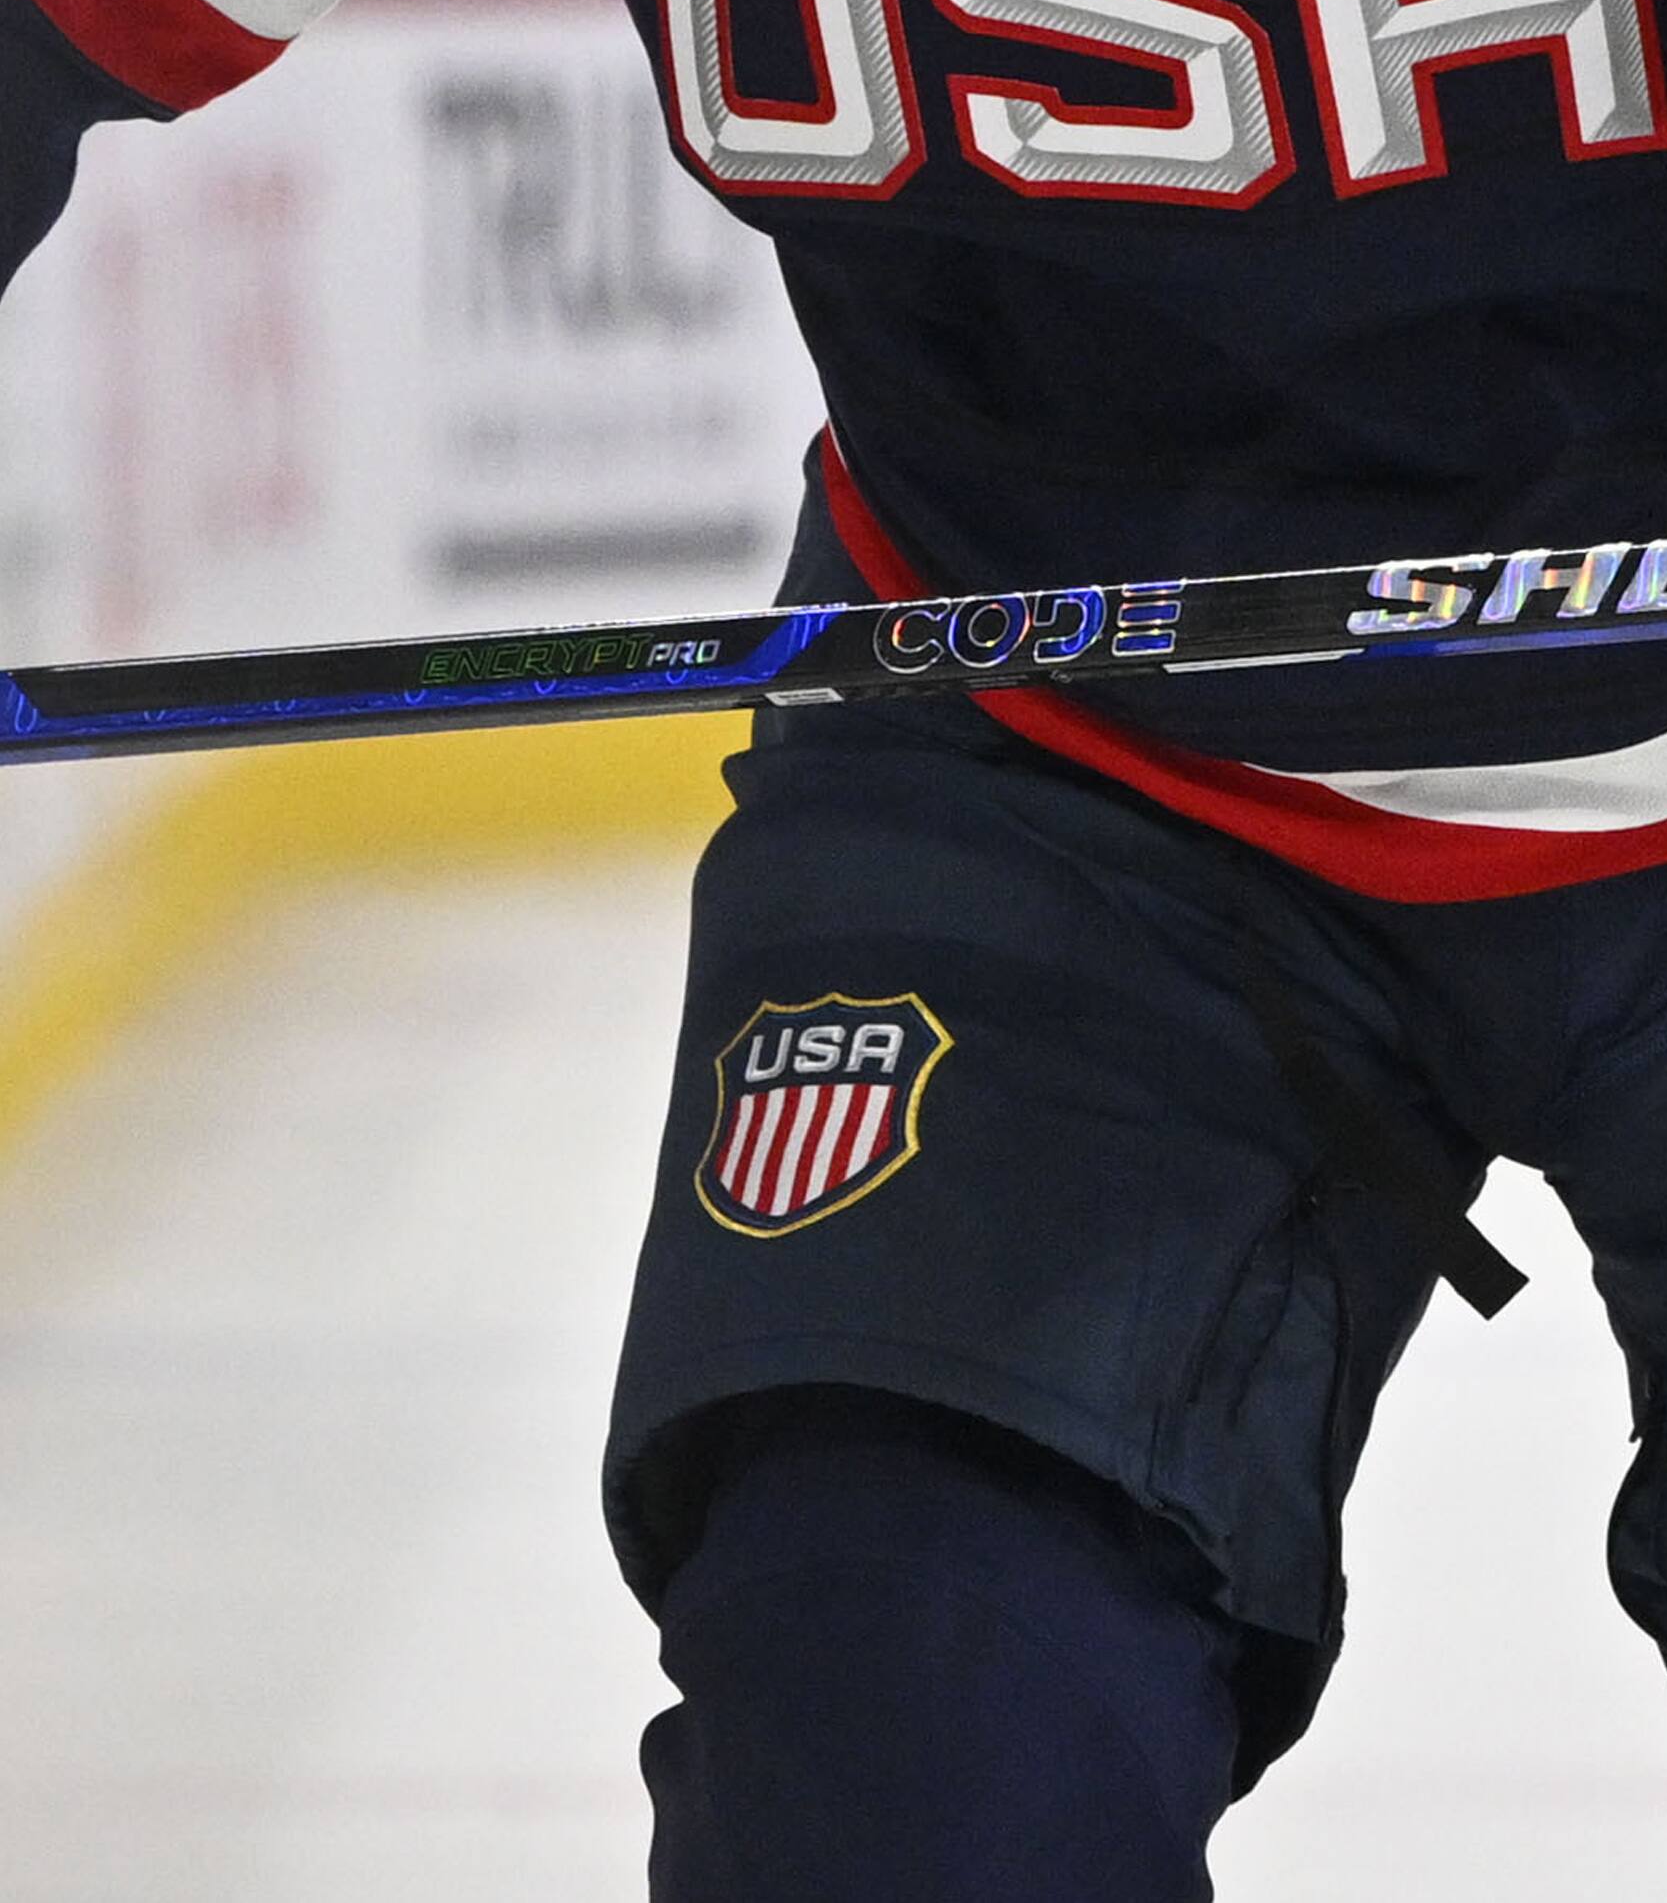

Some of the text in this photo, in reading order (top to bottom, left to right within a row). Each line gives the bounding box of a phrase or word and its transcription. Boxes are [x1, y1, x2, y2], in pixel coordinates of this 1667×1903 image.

[421, 633, 654, 684] ENCRYPT
[647, 639, 721, 669] PRO
[874, 578, 1187, 674] CODE
[745, 1023, 904, 1082] USA
